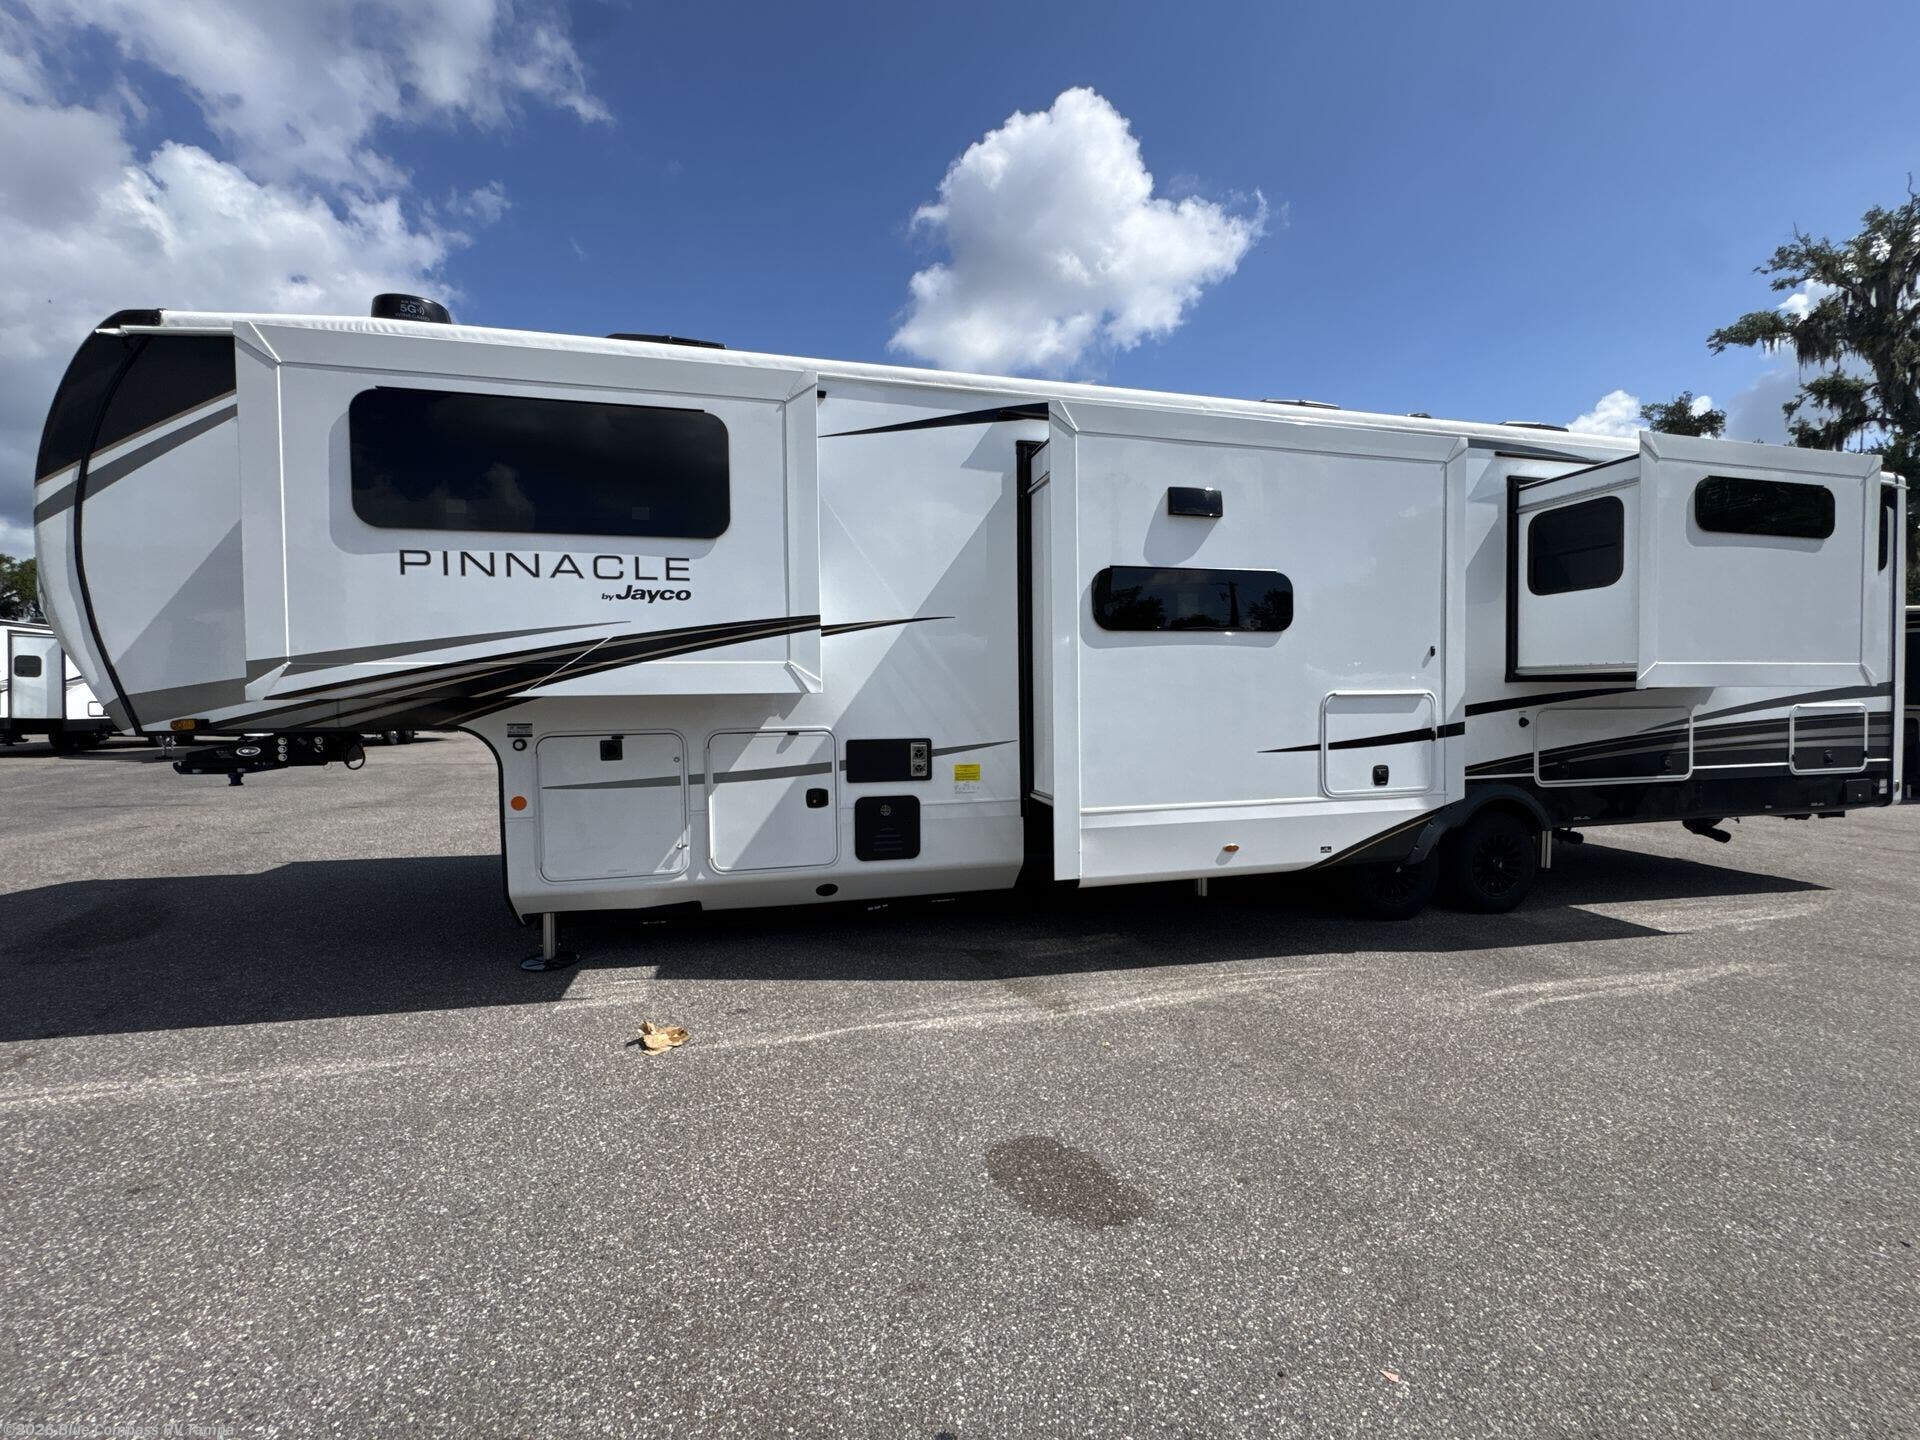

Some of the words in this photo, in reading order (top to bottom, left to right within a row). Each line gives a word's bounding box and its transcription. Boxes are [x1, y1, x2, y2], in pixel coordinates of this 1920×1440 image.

[400, 304, 417, 313] 5G
[399, 549, 690, 581] PINNACLE
[601, 593, 614, 602] by
[615, 584, 692, 603] Jayco
